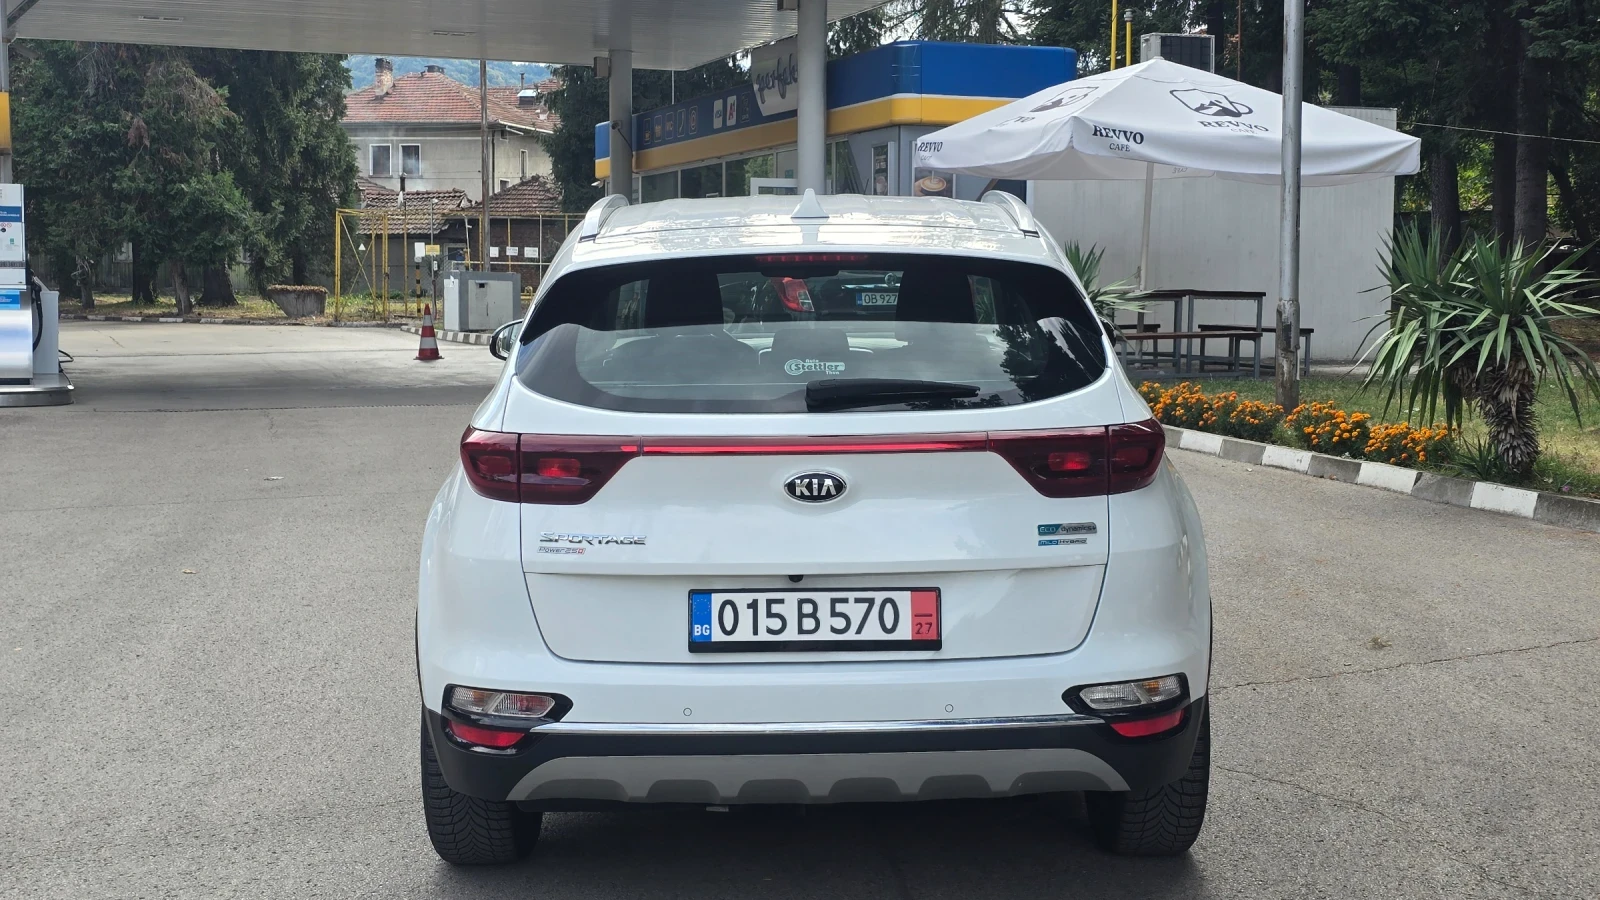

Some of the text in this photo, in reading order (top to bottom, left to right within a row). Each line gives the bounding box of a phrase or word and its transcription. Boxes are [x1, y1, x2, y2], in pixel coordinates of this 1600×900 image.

[1197, 120, 1269, 132] REVVO
[1092, 124, 1144, 145] REVVO
[794, 363, 840, 371] Stettler
[795, 478, 837, 496] KIA
[539, 531, 646, 546] SPORTAGE
[694, 624, 710, 636] BG
